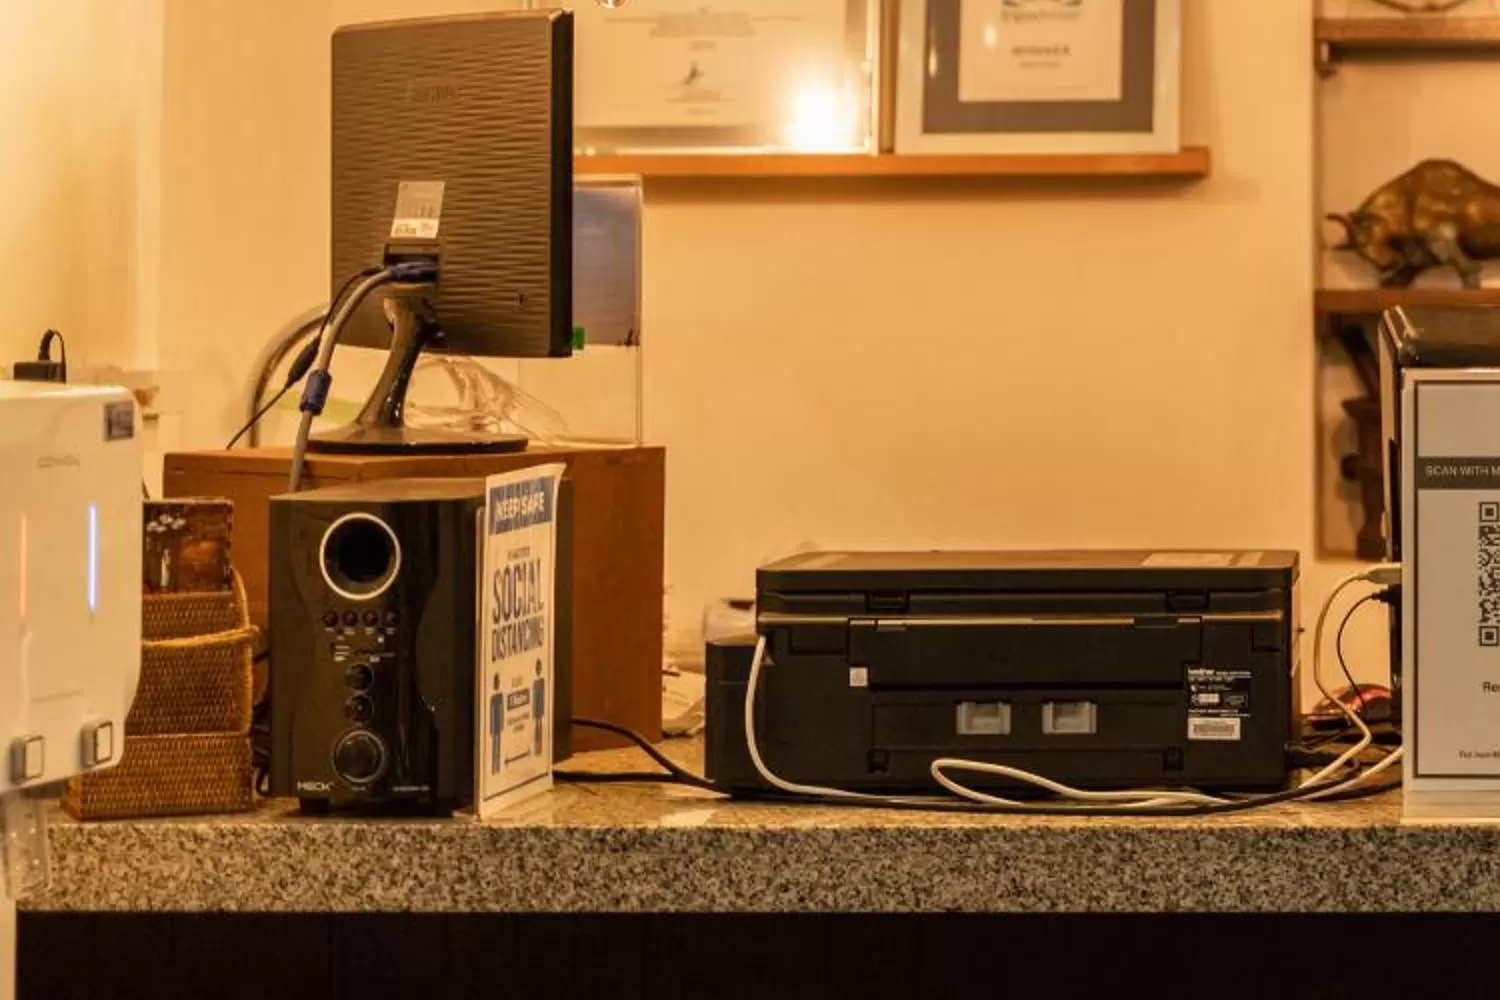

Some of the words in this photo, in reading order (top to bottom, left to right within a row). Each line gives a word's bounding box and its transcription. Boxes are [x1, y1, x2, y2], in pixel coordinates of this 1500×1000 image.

[1425, 465, 1457, 477] SCAN
[1459, 465, 1489, 477] WITH
[492, 557, 544, 625] SOCIAL
[491, 614, 545, 663] DISTANCING
